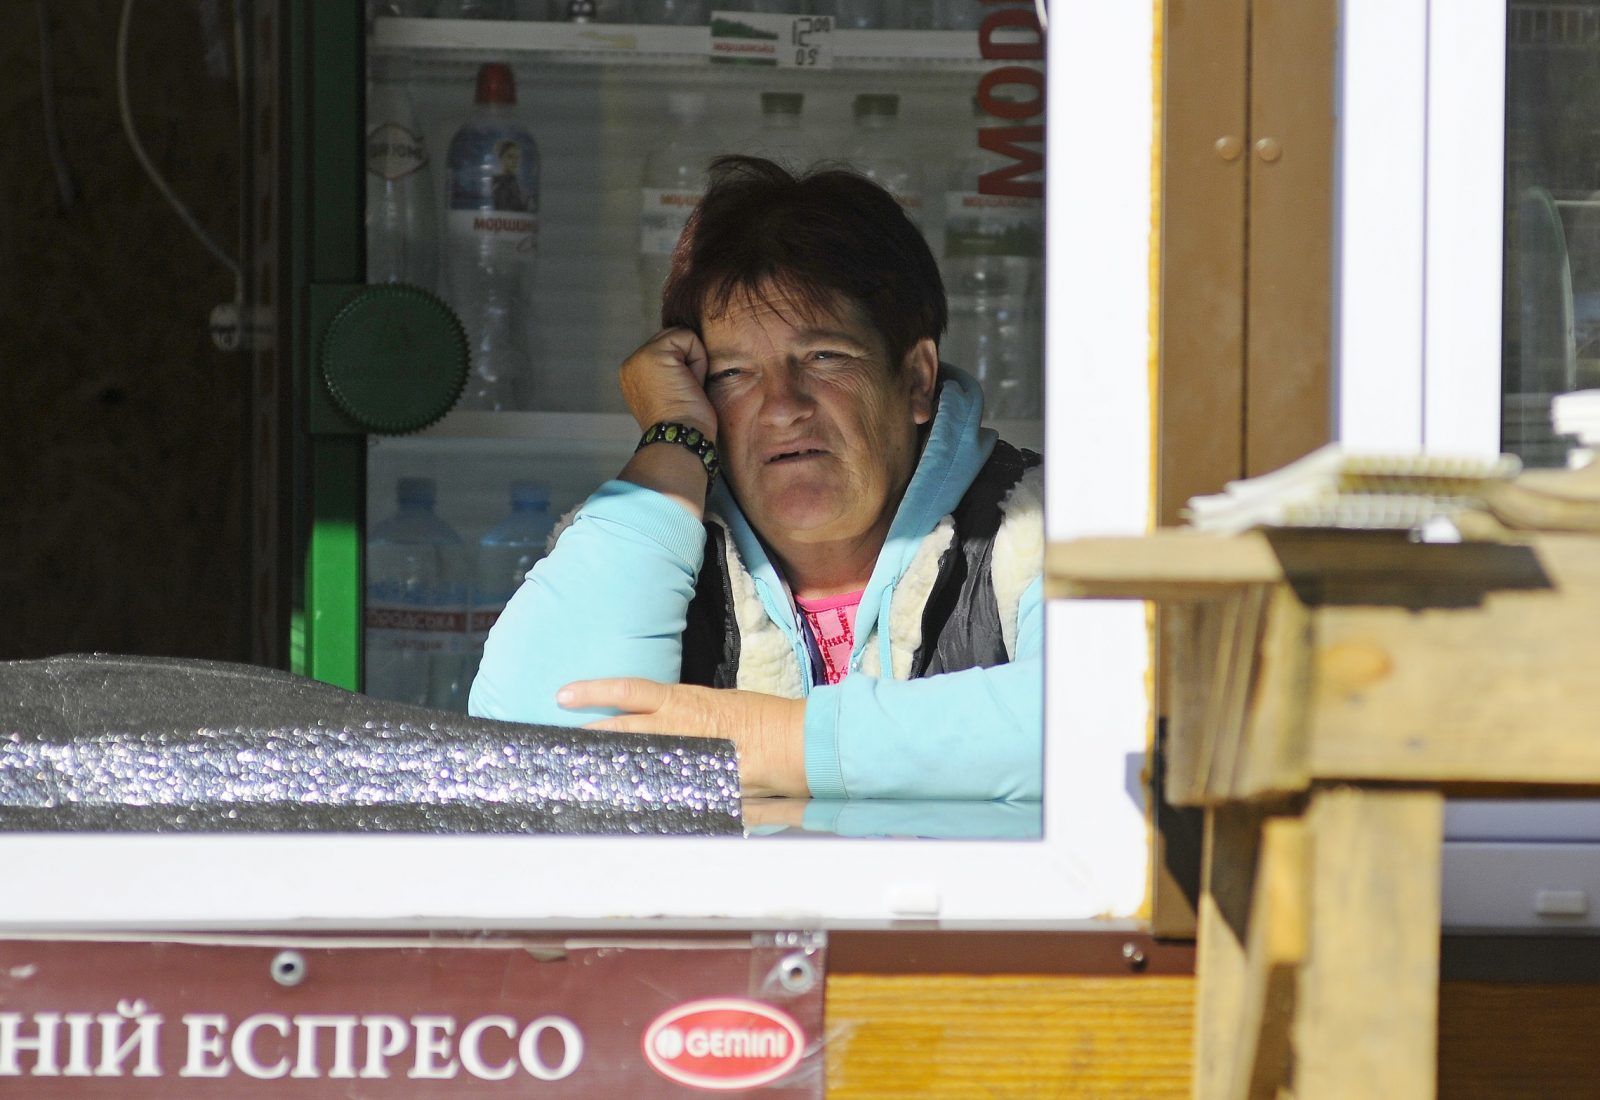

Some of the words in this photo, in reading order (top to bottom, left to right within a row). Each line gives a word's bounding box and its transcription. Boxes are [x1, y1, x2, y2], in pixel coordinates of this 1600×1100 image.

[977, 0, 1045, 197] MOD
[0, 998, 163, 1077] НІЙ
[179, 1012, 583, 1081] ЕСПРЕСО
[686, 1027, 788, 1058] GEMINI
